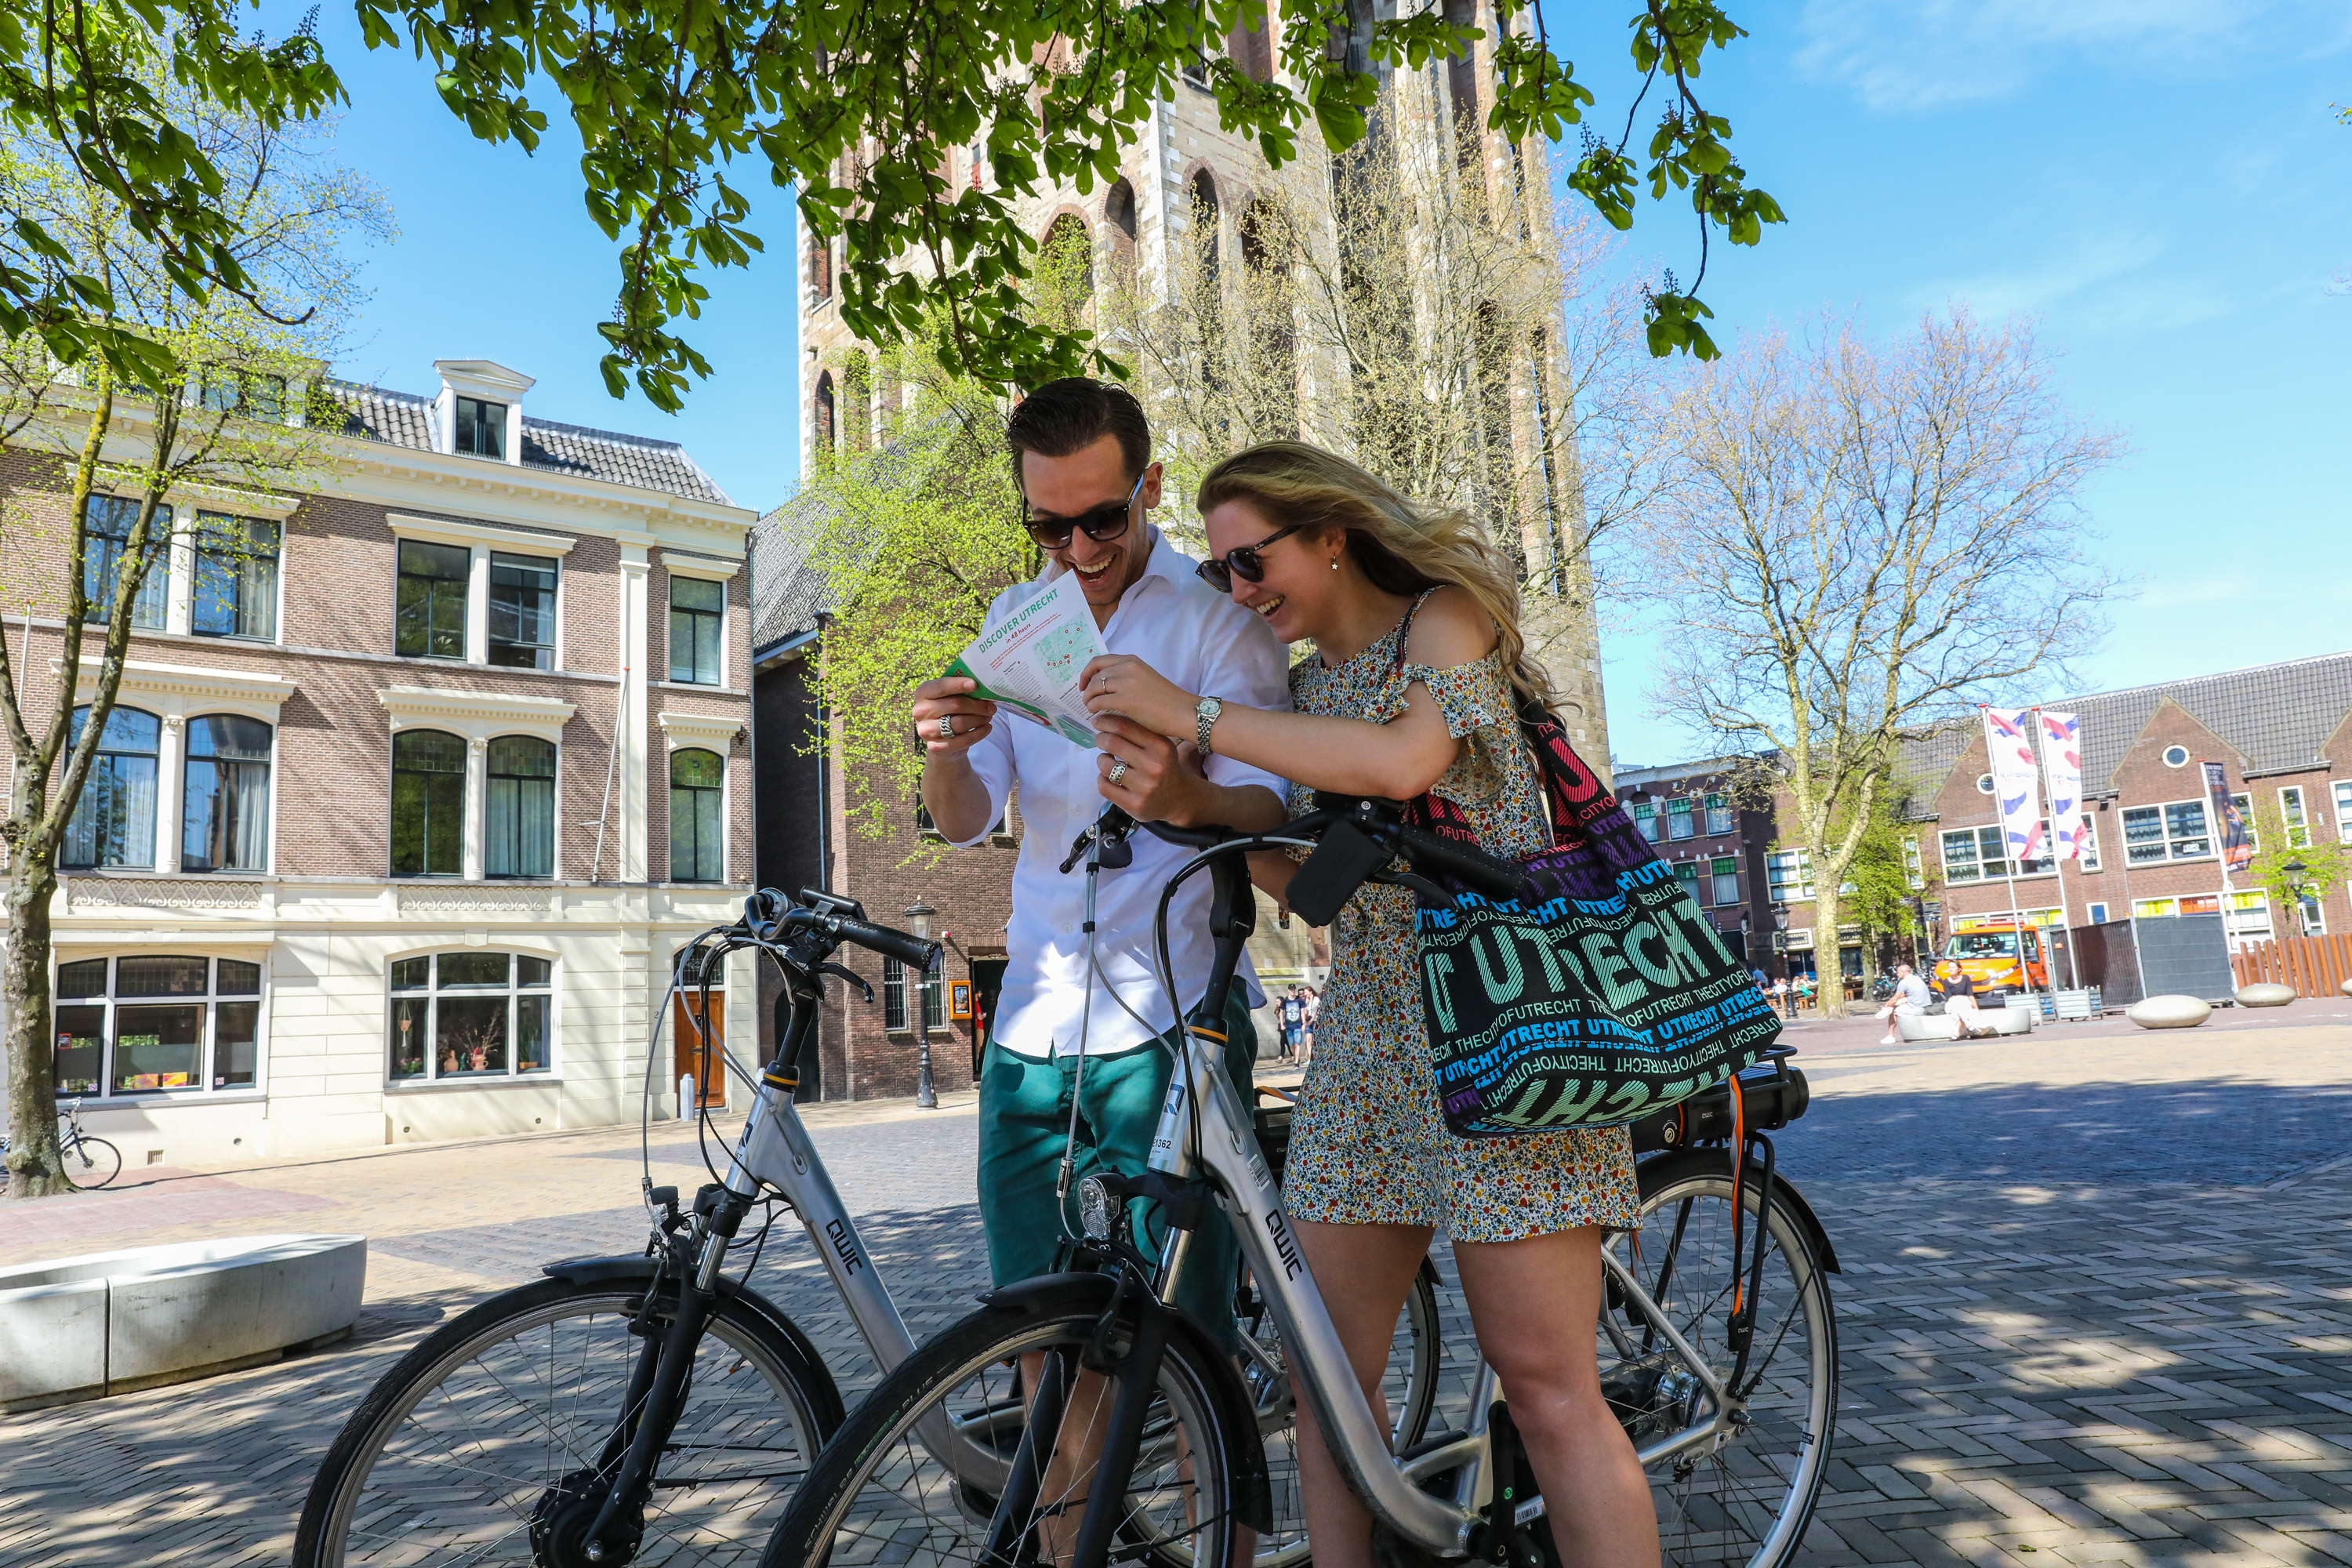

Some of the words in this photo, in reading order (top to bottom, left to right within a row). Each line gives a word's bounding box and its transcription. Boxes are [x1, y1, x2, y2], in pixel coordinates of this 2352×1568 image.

[978, 616, 1020, 654] DISCOVER
[1019, 588, 1059, 622] UTRECHT
[1018, 622, 1031, 634] hours
[1455, 998, 1581, 1054] THECITYOFUTRECHT
[1499, 1019, 1580, 1054] UTRECHT
[1657, 1005, 1721, 1040] UTRECHT
[1490, 1054, 1607, 1109] THECITYOFUTRECHT
[1614, 1040, 1726, 1074] THECITYOFUTRECHT
[826, 1218, 862, 1276] QWIC
[1265, 1208, 1303, 1282] QWIC
[804, 1468, 854, 1549] SCHWALBE
[902, 1376, 933, 1410] PLUS
